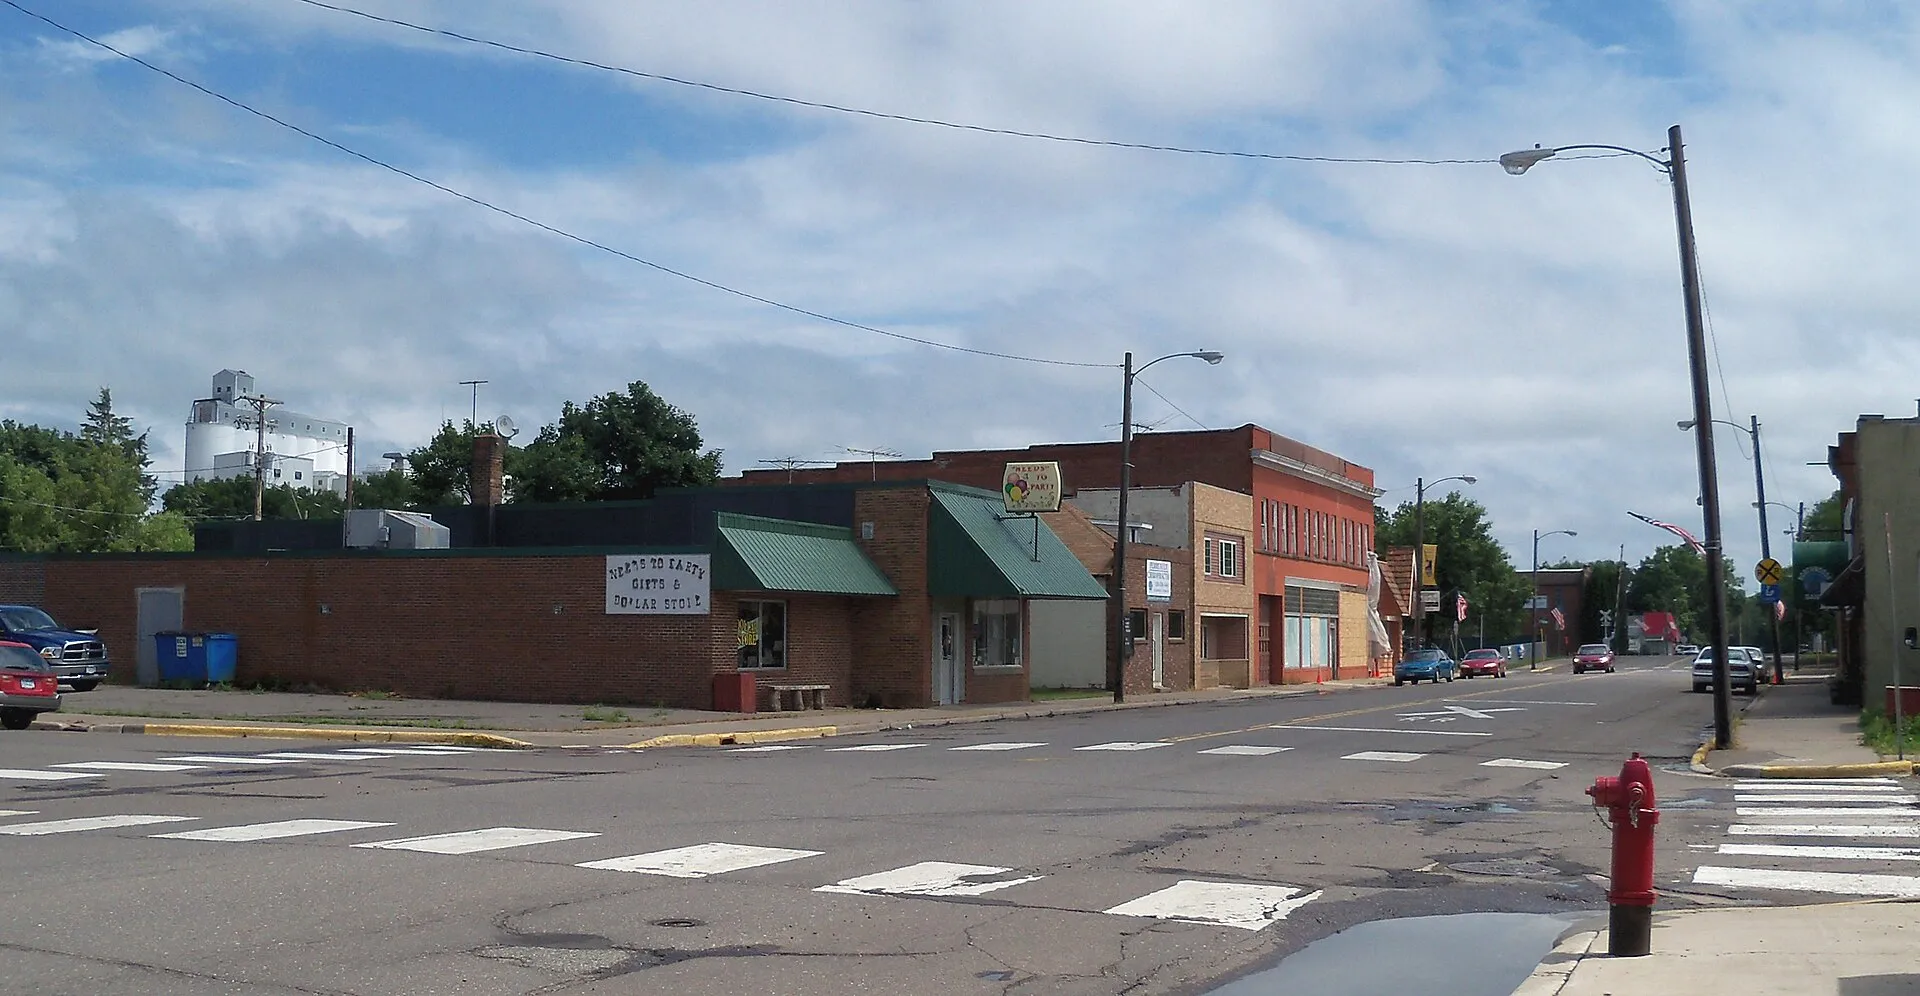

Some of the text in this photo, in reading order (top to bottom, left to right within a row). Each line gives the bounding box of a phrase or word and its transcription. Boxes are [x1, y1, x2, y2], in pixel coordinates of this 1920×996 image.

[650, 557, 664, 569] TO
[632, 578, 681, 590] GIFTS &
